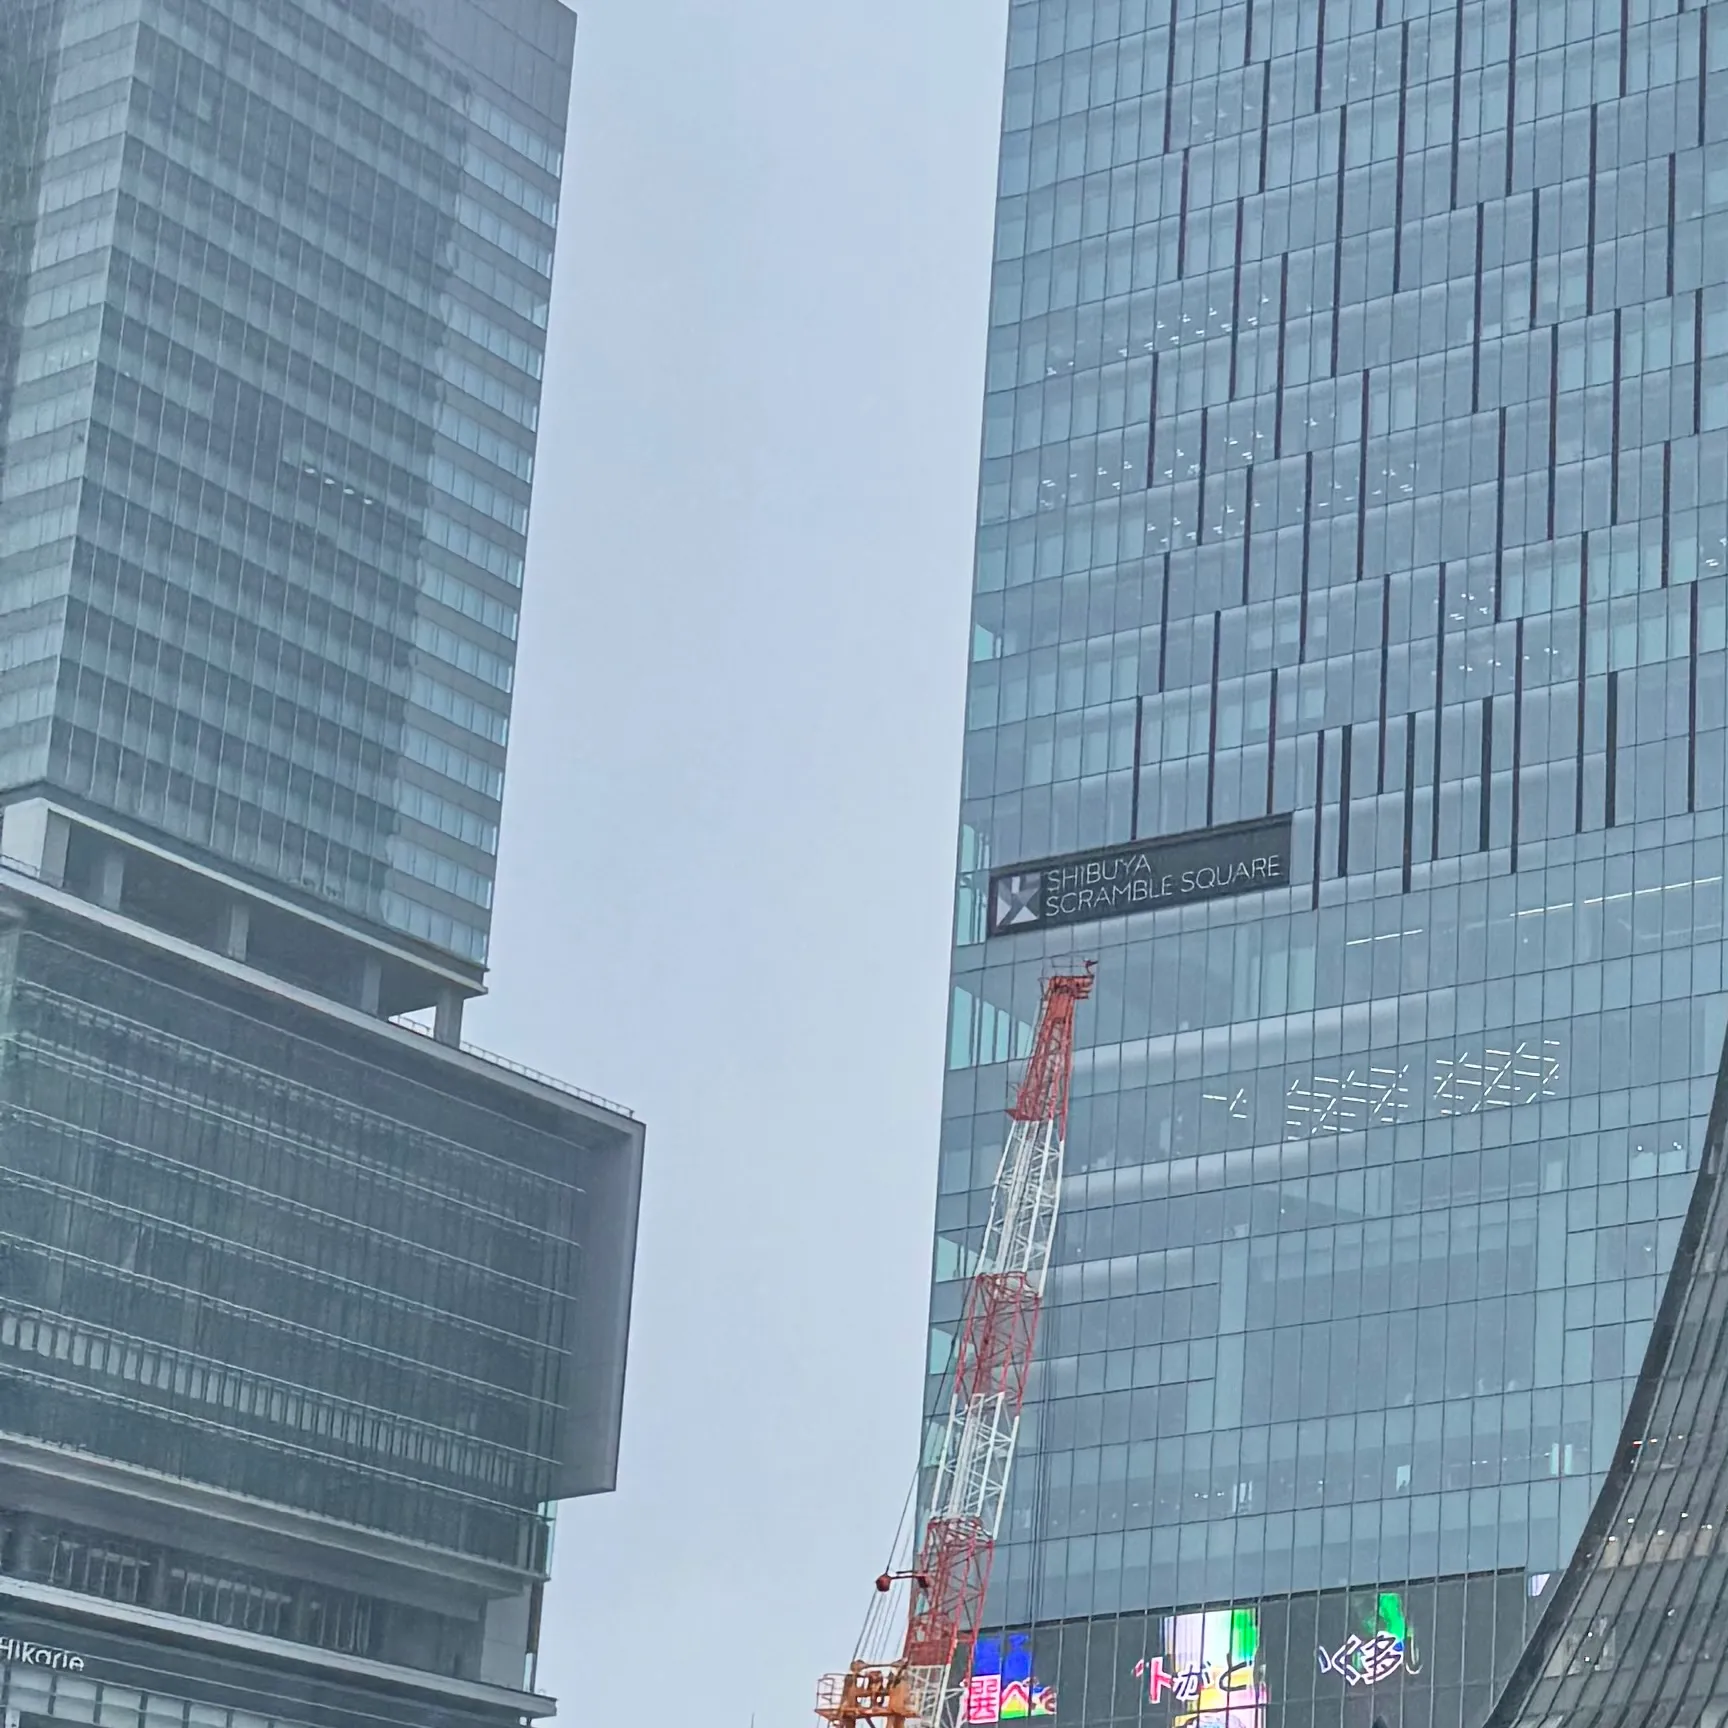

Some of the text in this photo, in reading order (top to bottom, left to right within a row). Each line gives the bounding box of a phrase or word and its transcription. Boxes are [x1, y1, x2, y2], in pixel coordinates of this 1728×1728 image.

[1045, 854, 1283, 917] SCRAMBLE SQUARE
[1046, 854, 1151, 892] SHIBUYA
